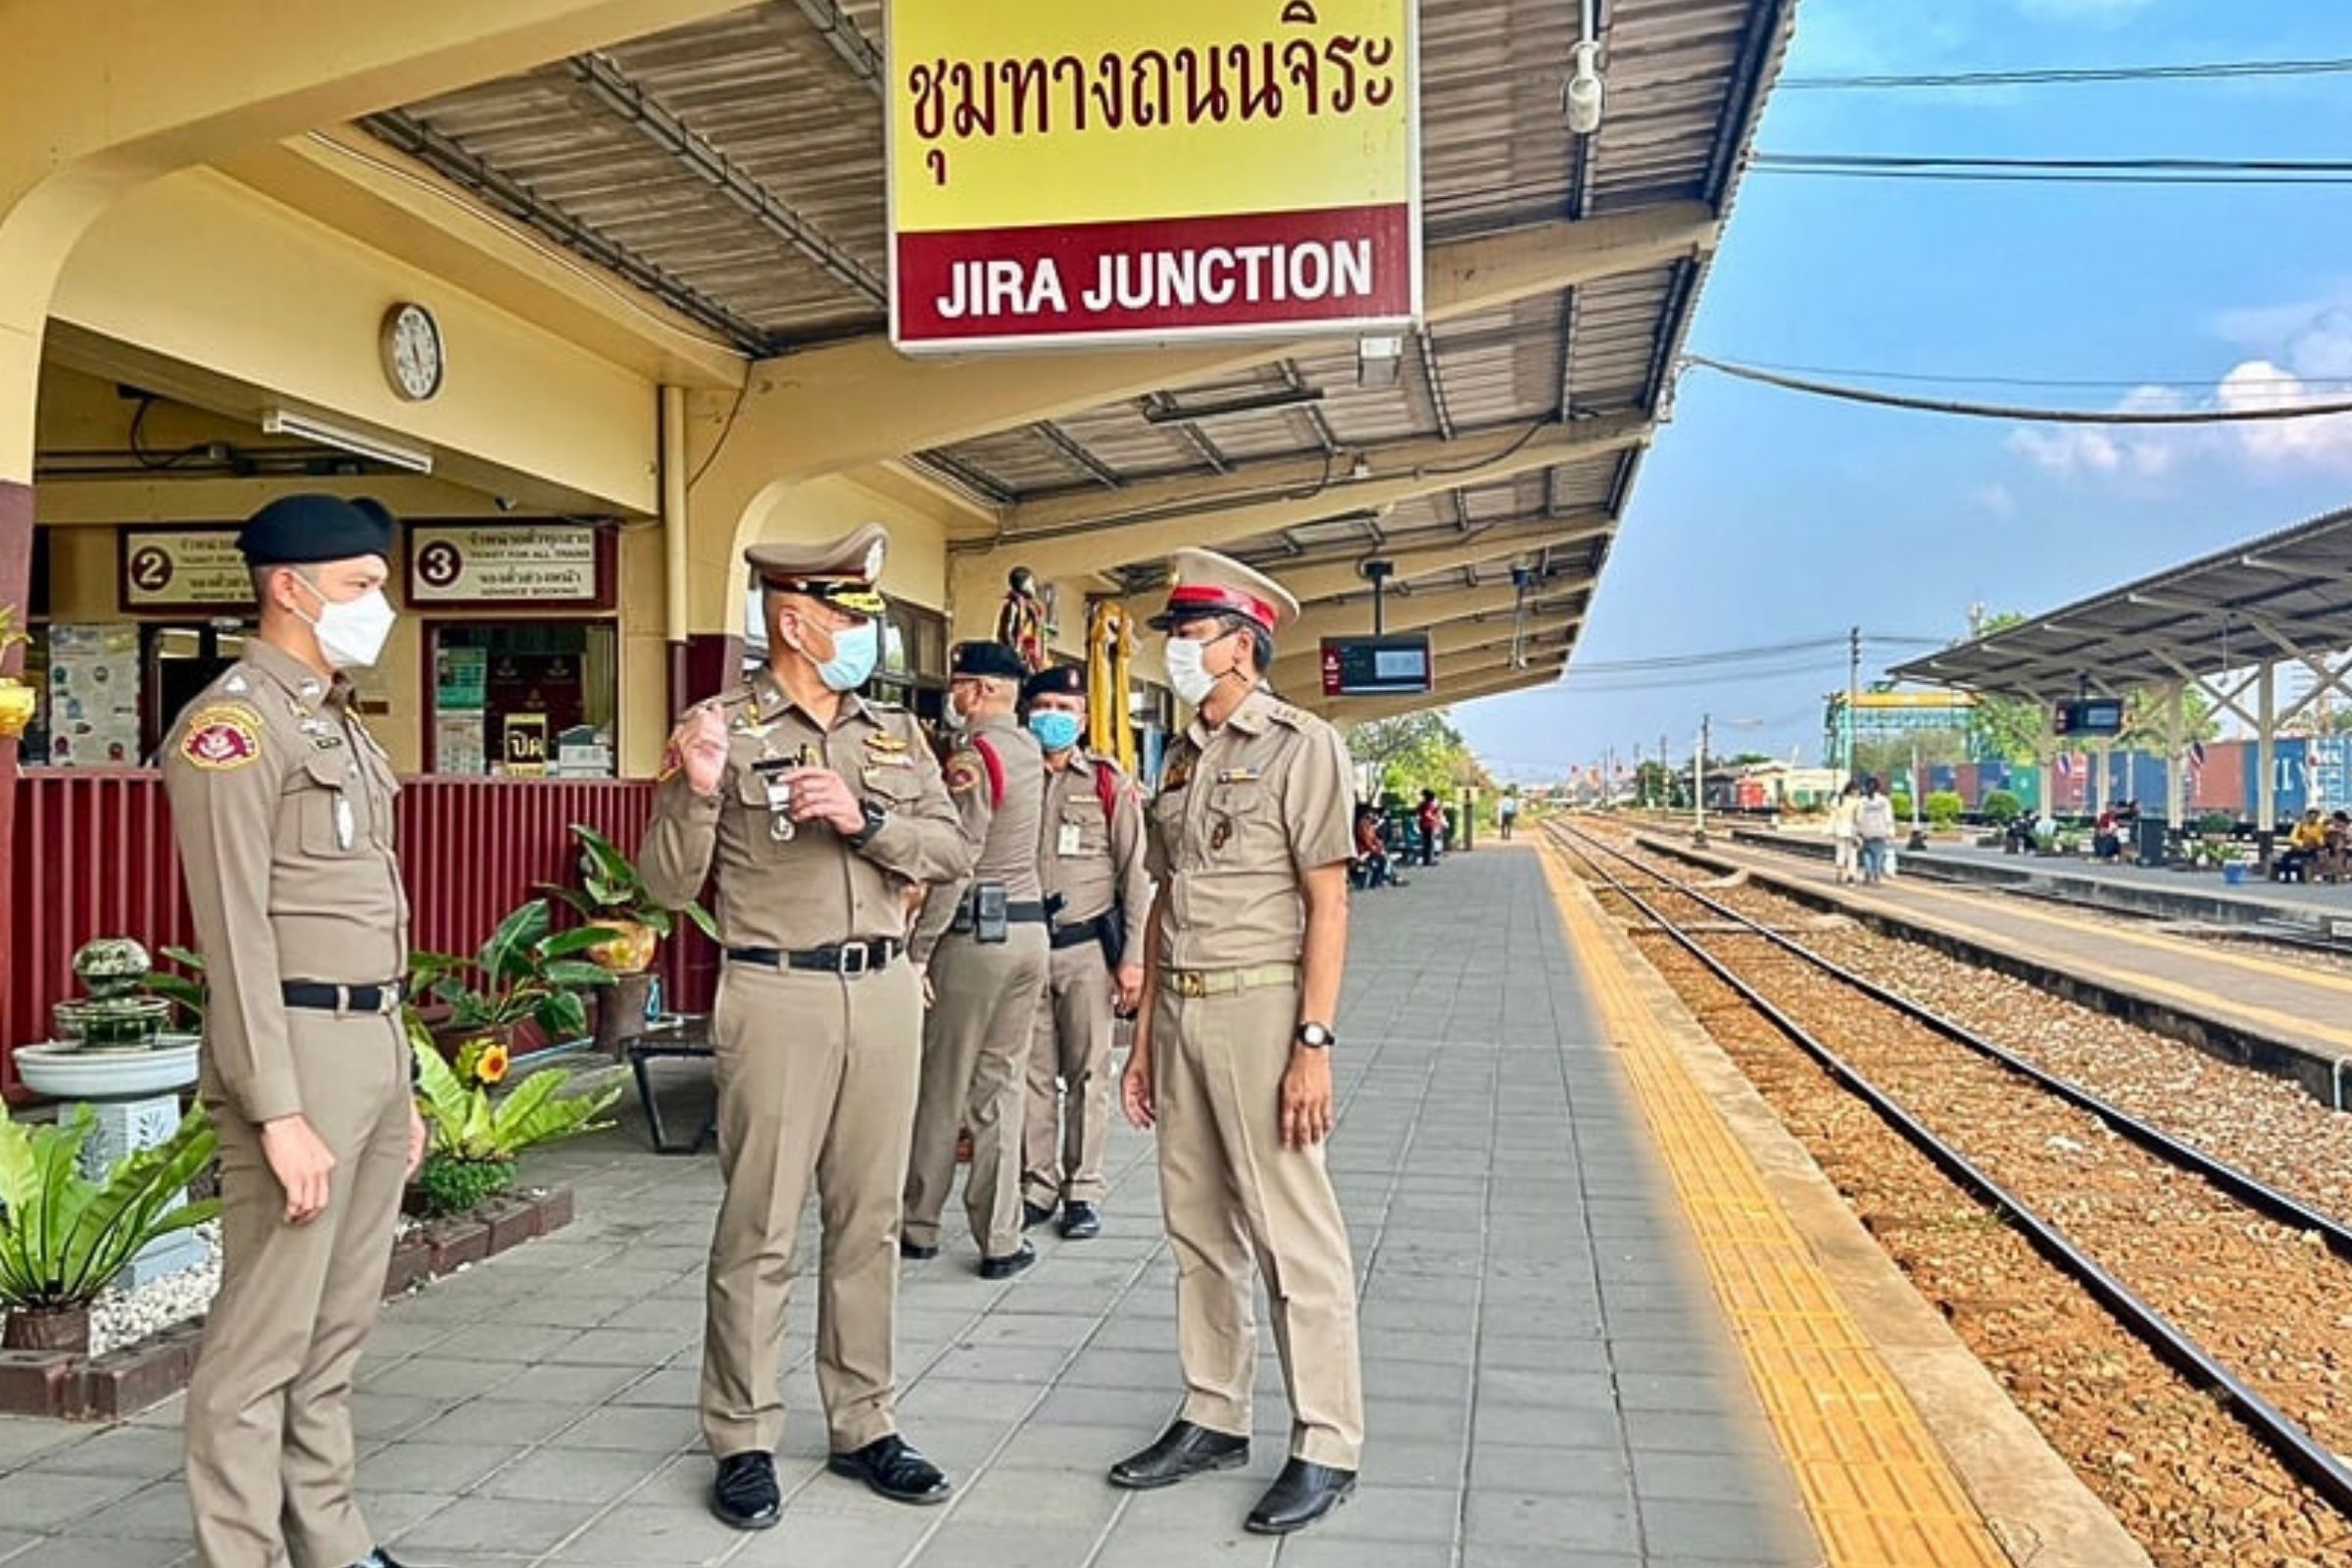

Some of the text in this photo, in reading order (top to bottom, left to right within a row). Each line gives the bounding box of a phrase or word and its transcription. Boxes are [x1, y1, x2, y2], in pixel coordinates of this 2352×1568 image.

[909, 0, 1394, 185] ชุมทางถนนจิระ
[936, 238, 1372, 318] JIRA JUNCTION
[140, 552, 165, 584] 2
[426, 547, 454, 580] 3
